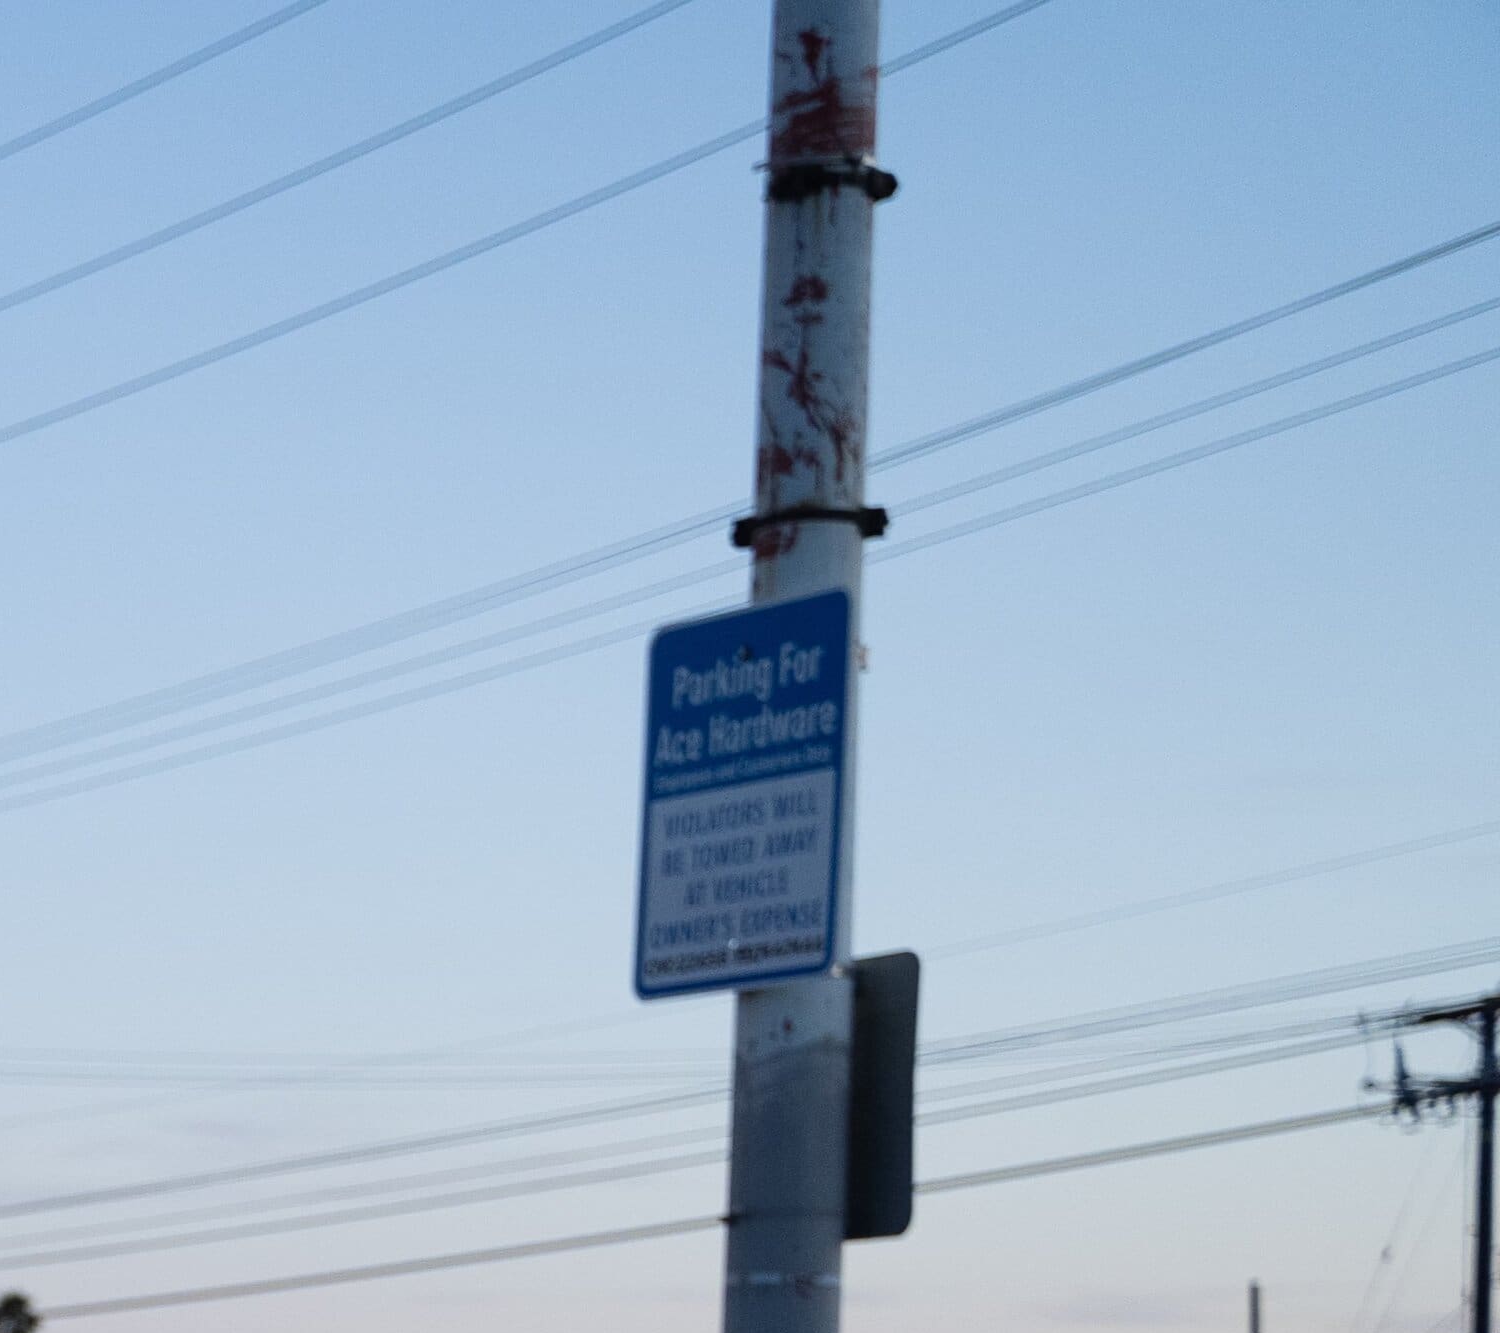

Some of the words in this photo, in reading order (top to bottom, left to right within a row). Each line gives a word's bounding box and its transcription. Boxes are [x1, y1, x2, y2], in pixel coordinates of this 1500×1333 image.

[671, 653, 774, 709] Parking
[778, 641, 825, 687] For
[653, 725, 702, 767] Ace
[708, 700, 839, 759] Hardware
